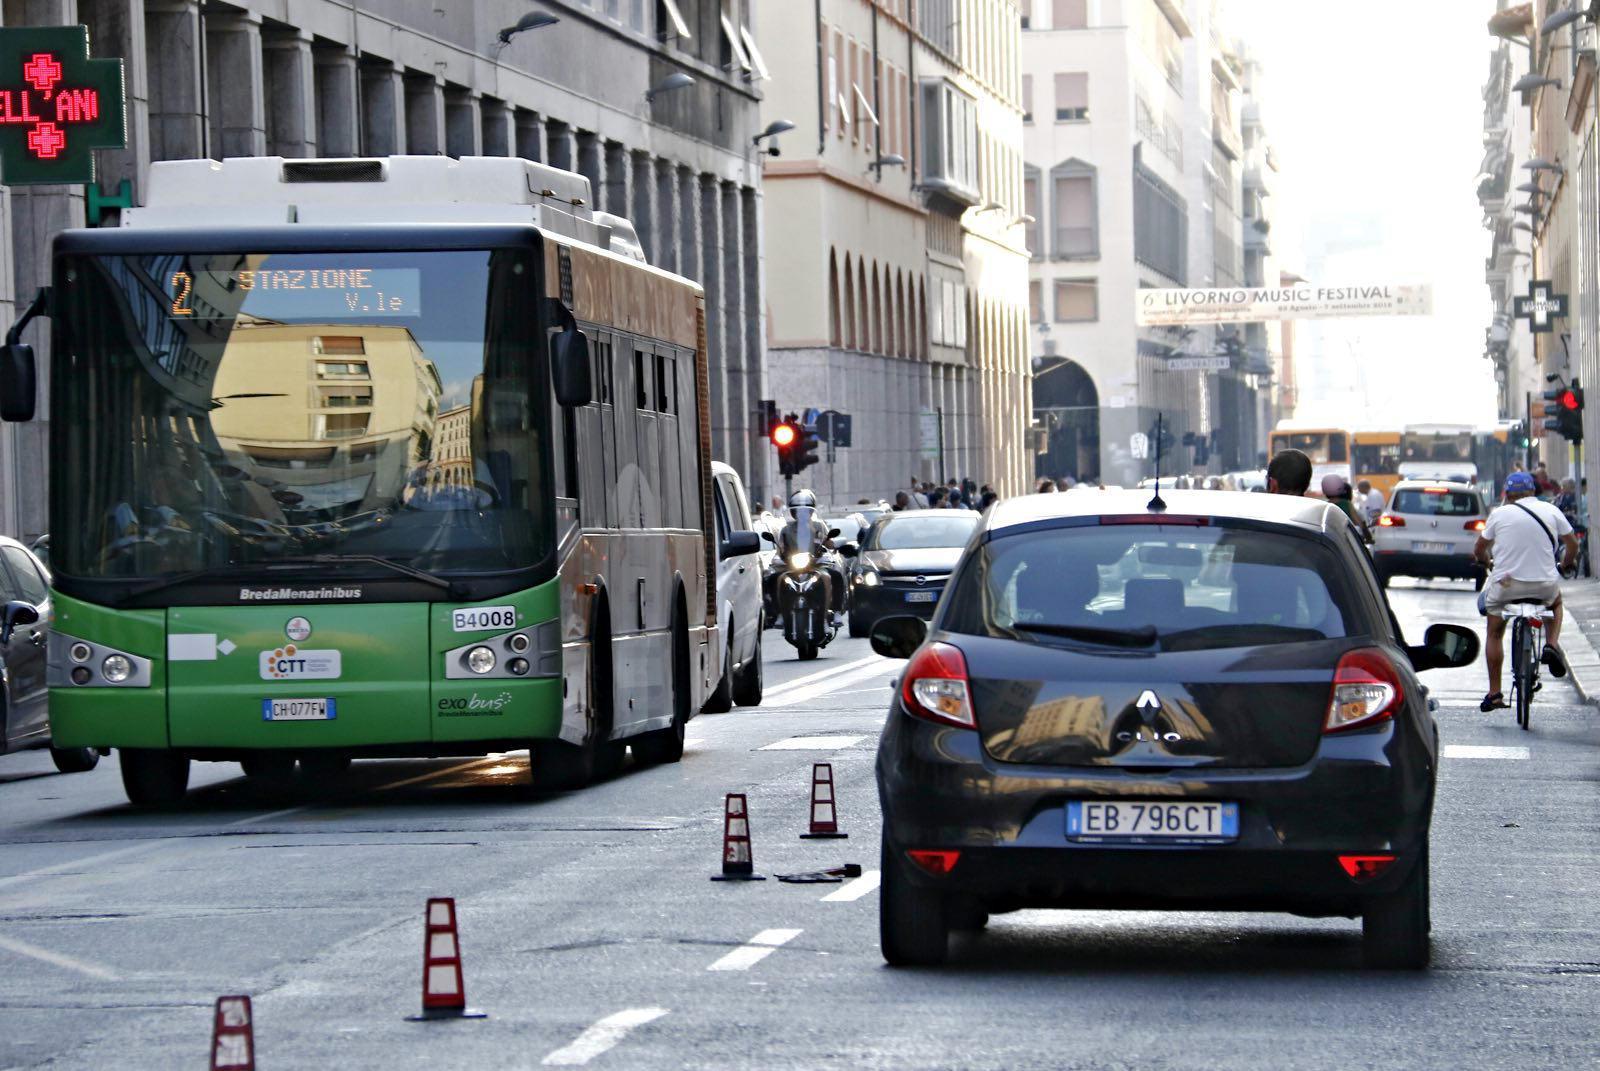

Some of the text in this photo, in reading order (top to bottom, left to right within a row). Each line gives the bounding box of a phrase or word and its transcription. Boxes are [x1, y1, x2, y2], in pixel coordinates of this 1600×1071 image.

[239, 269, 373, 290] STAZIONE
[172, 271, 192, 315] 2
[345, 292, 403, 312] V.le
[1165, 291, 1247, 306] LIVORNO
[1252, 289, 1311, 303] MUSIC
[1317, 286, 1392, 300] FESTIVAL
[239, 587, 362, 600] BredaMenarinibus
[455, 611, 514, 629] B4008
[277, 659, 306, 673] CTT
[1116, 731, 1181, 743] CLIO
